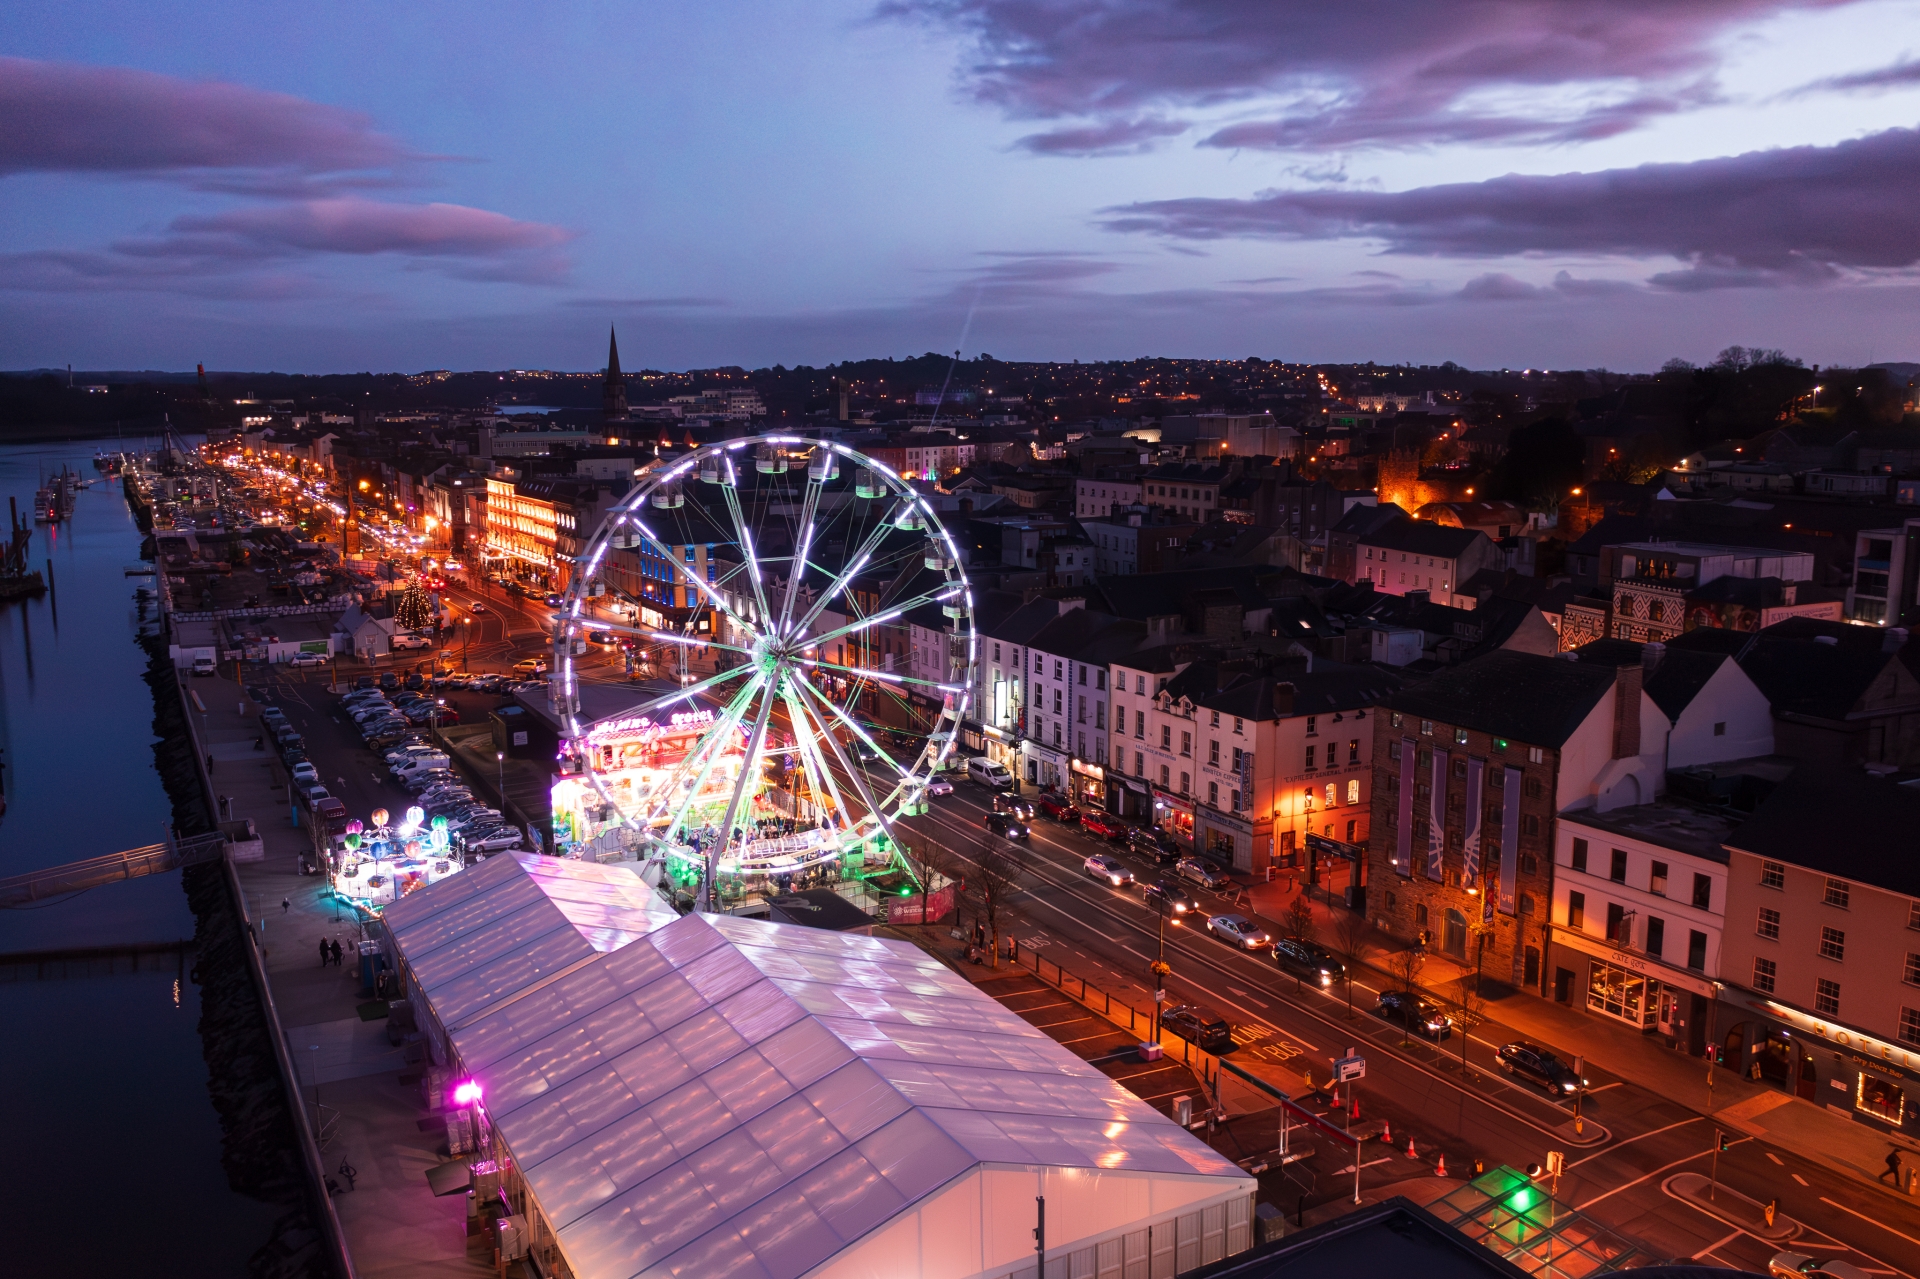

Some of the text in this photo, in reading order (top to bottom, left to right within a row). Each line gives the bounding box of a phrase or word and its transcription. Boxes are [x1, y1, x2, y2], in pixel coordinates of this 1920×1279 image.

[1223, 773, 1242, 784] EXPRES
[1017, 935, 1051, 950] BUS
[1262, 1040, 1304, 1061] BUS
[1813, 1021, 1914, 1069] HOTEL
[1852, 1055, 1868, 1067] Dry
[1889, 1068, 1905, 1079] Bar
